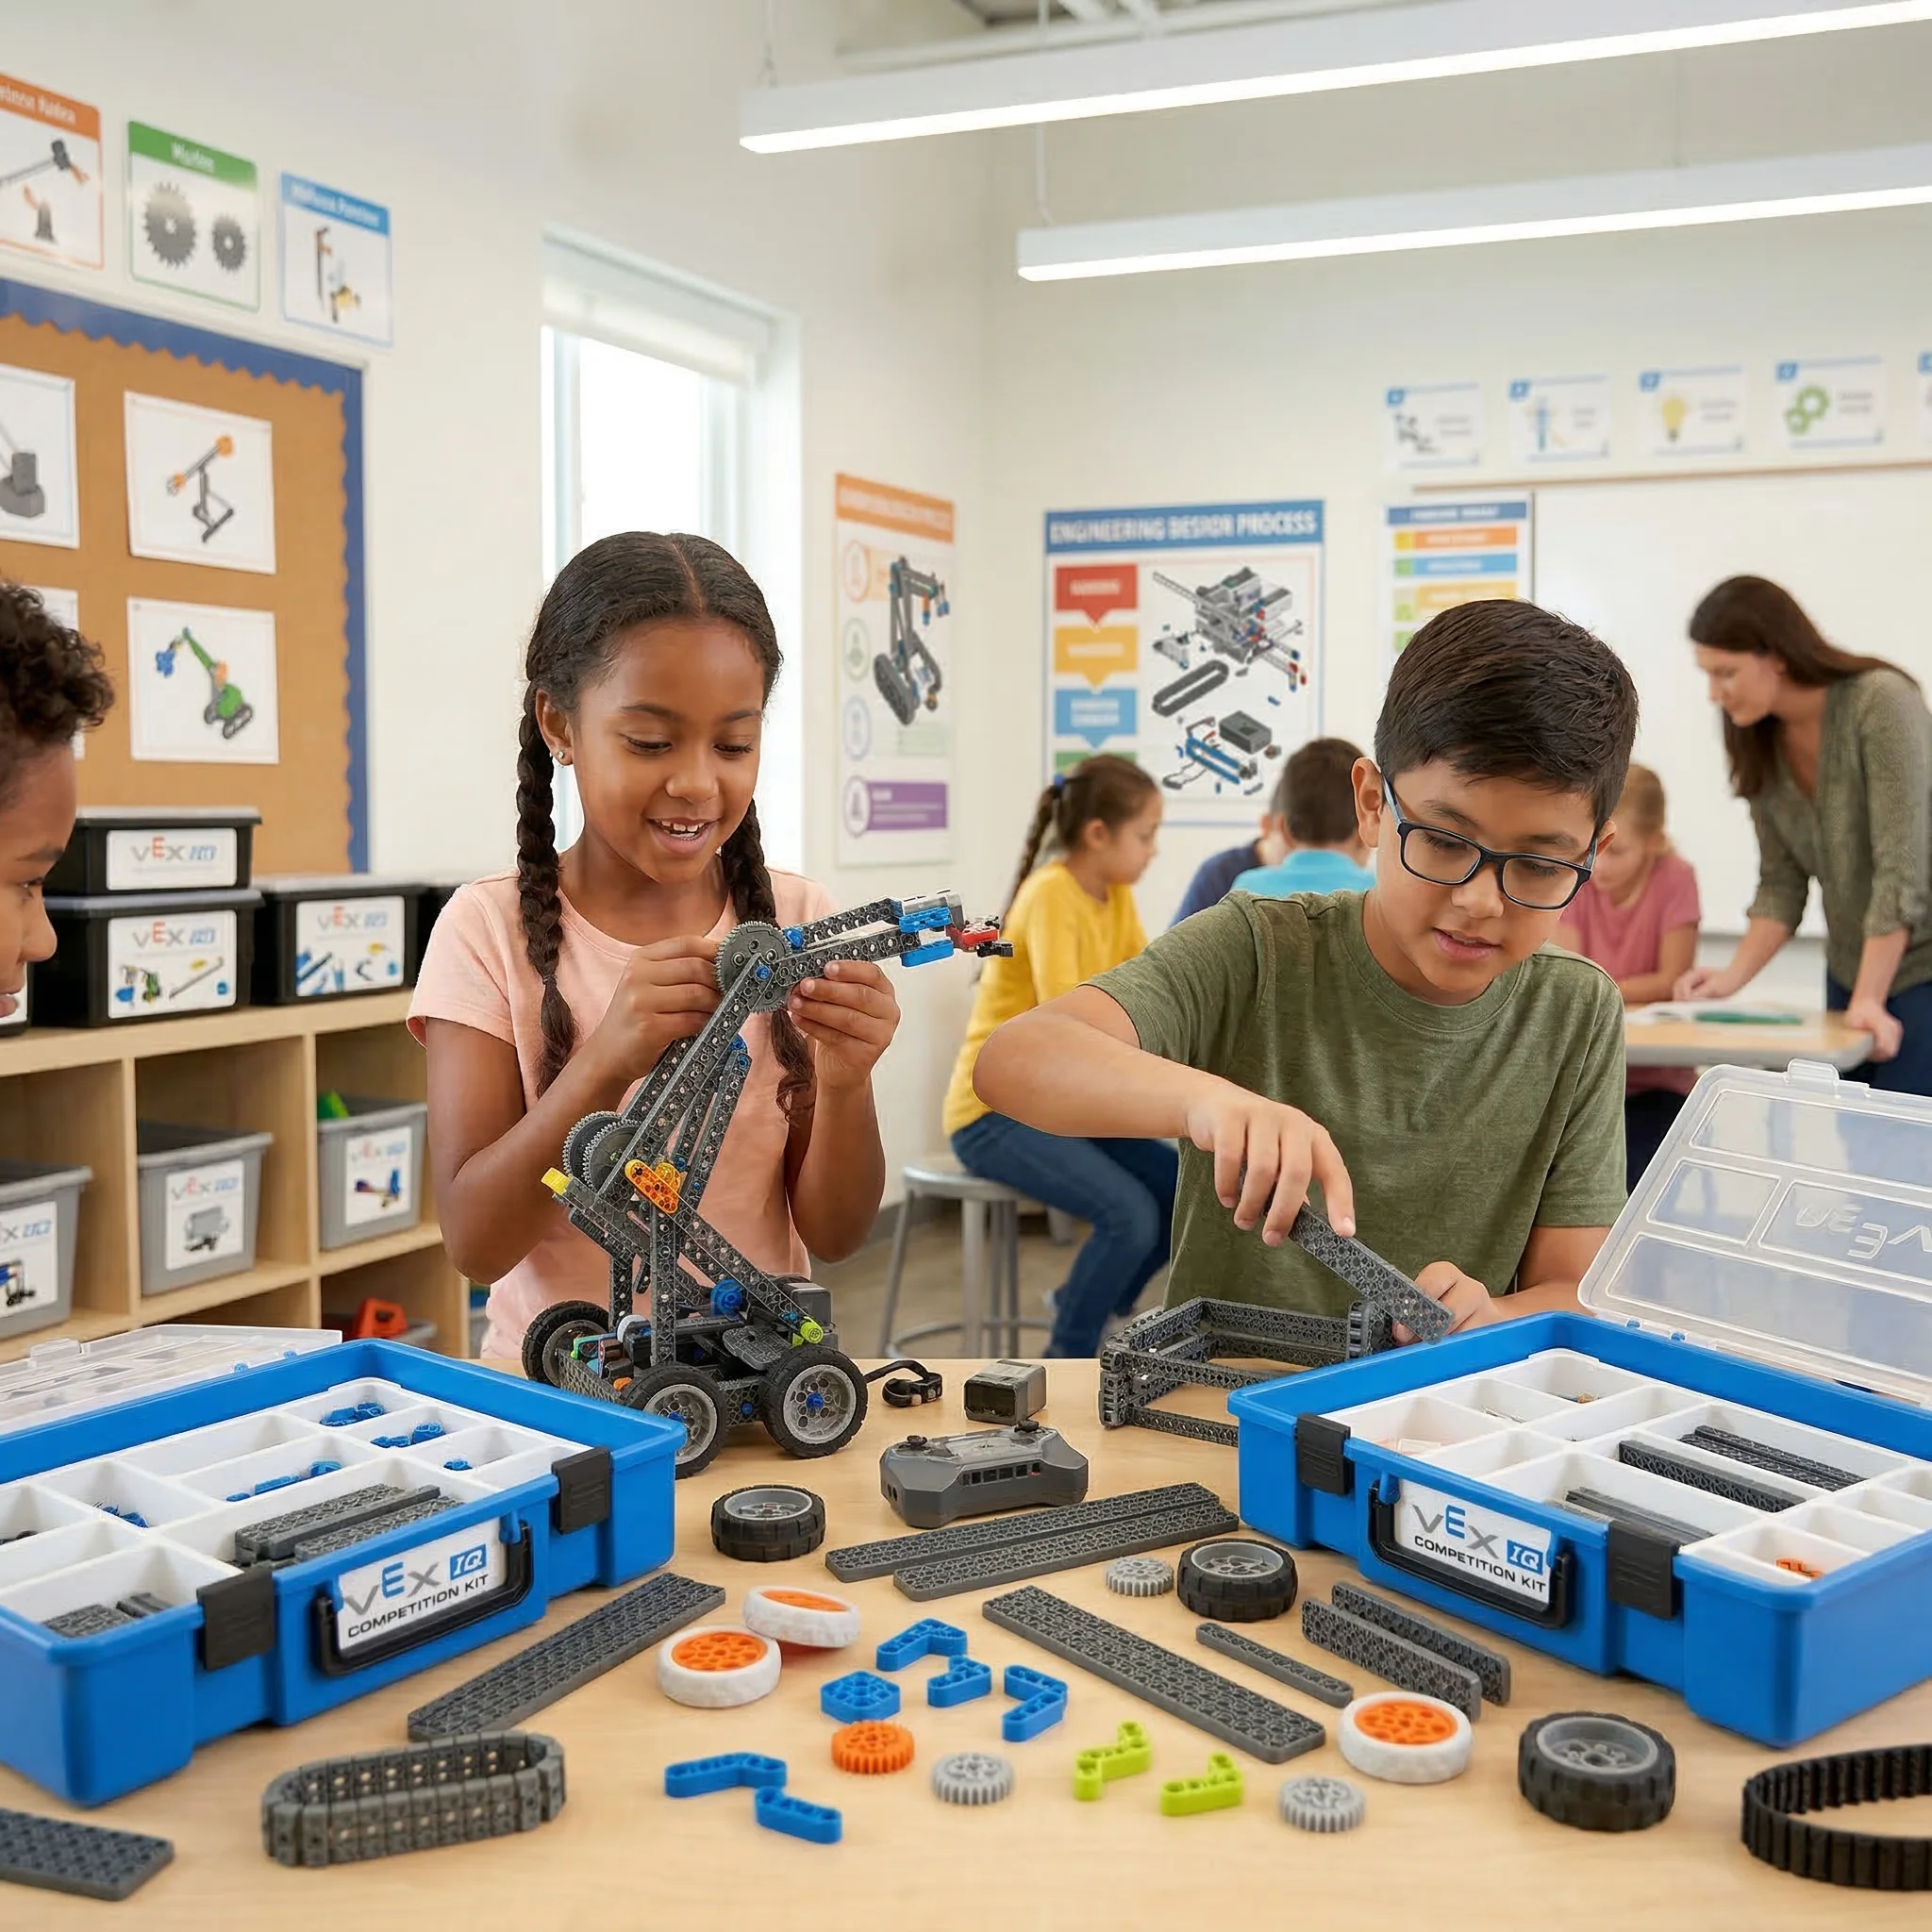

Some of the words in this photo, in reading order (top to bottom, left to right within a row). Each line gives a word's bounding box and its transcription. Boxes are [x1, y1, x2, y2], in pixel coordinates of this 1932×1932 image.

[1237, 510, 1317, 536] PROCESS
[1412, 1504, 1499, 1559] VEX
[1508, 1543, 1541, 1572] IQ
[1414, 1535, 1516, 1582] COMPETITION
[1522, 1574, 1547, 1593] KIT
[344, 1560, 441, 1616] VEX
[452, 1548, 484, 1576] IQ
[348, 1585, 459, 1639] COMPETITION
[464, 1574, 489, 1593] KIT
